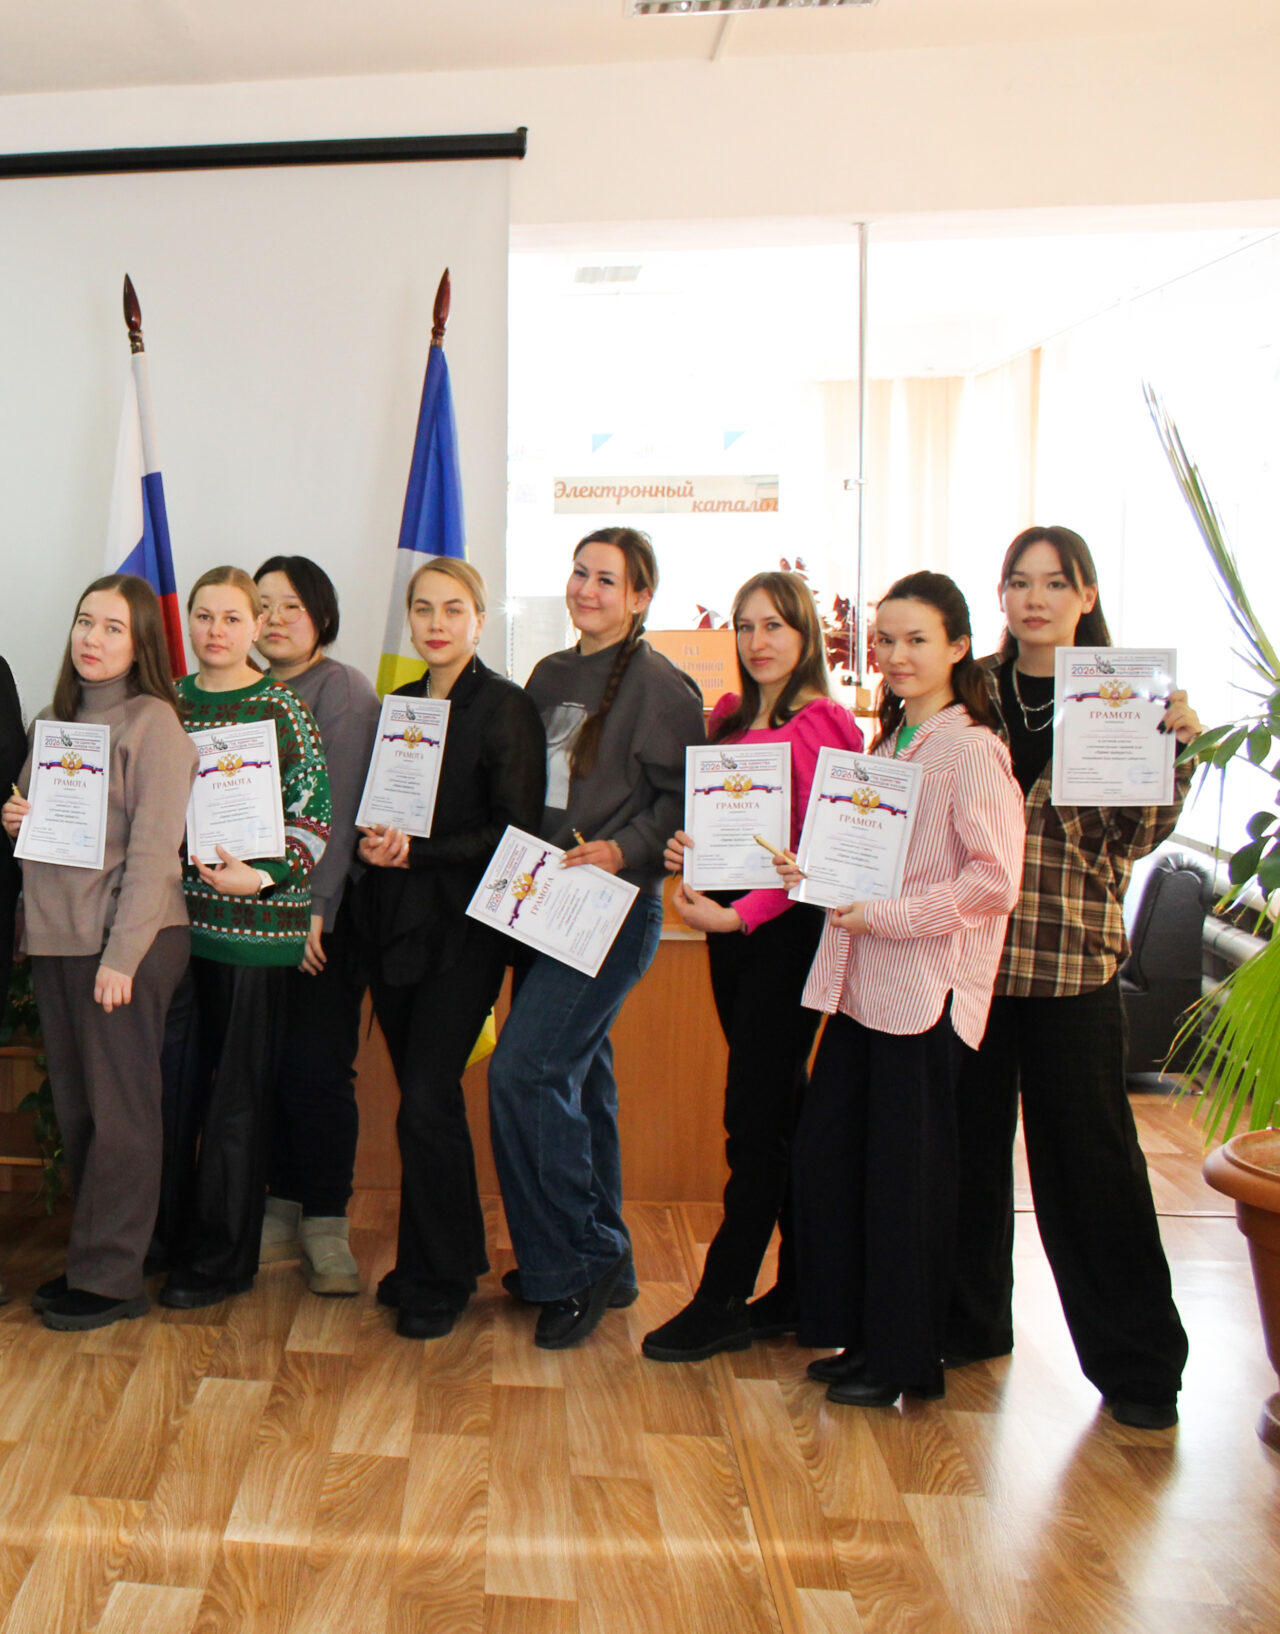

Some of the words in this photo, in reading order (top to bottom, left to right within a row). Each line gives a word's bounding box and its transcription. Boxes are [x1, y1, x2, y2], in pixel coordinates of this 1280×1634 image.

[554, 480, 695, 505] Электронный
[1072, 666, 1095, 675] 2026
[1089, 711, 1141, 719] ГРАМОТА
[53, 777, 87, 789] ГРАМОТА
[212, 778, 252, 790] ГРАМОТА
[715, 801, 760, 809] ГРАМОТА
[839, 814, 883, 829] ГРАМОТА
[530, 876, 555, 916] ГРАМОТА
